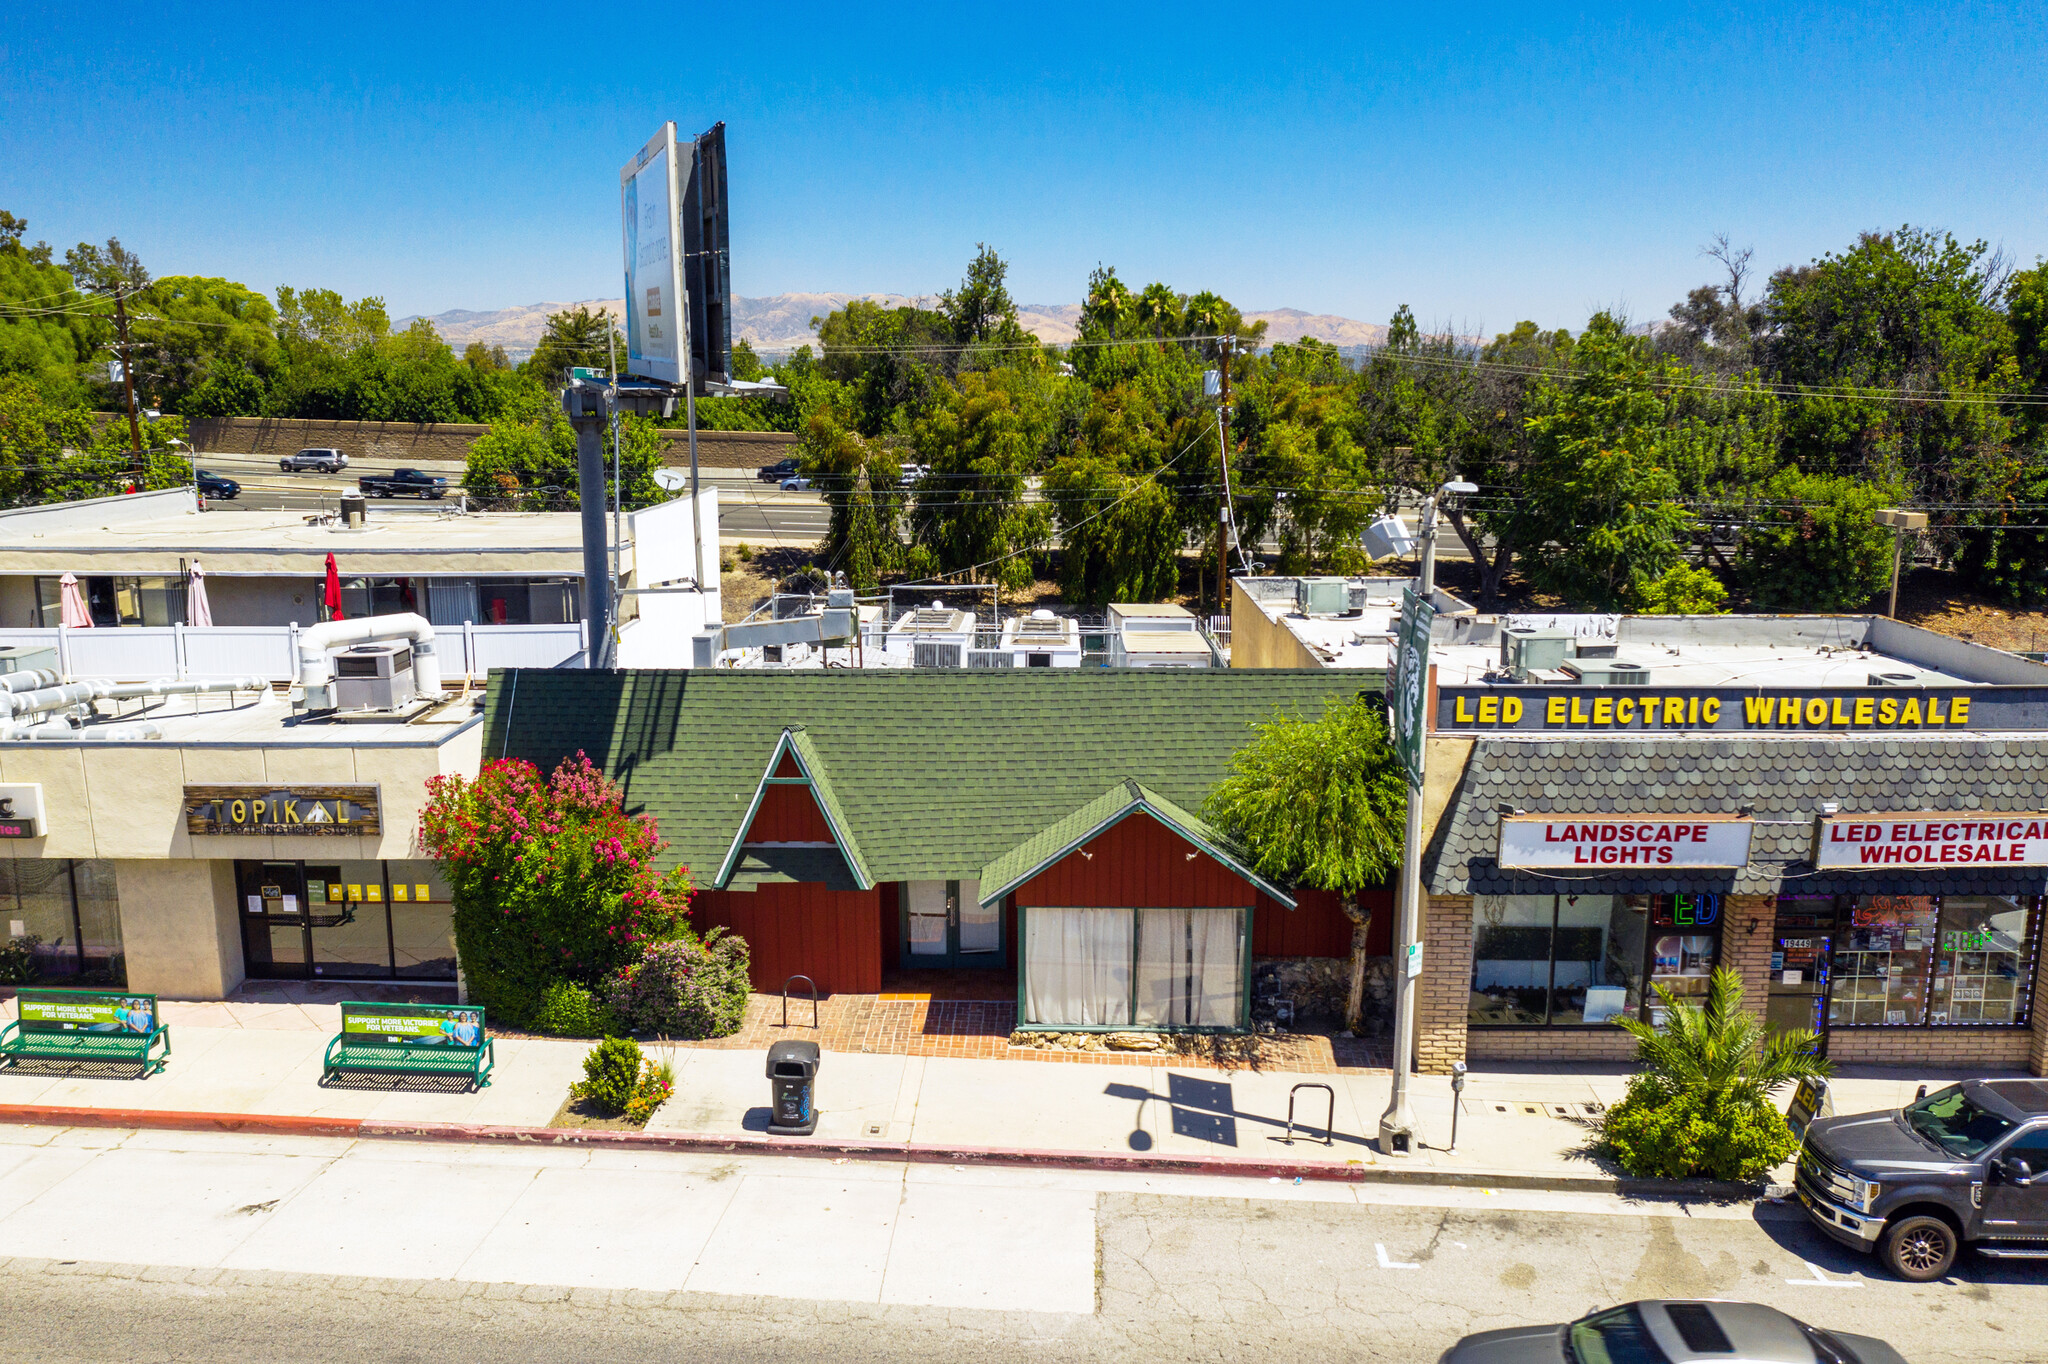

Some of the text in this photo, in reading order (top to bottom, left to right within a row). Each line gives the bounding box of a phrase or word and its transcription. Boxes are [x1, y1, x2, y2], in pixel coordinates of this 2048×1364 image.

[1455, 696, 1972, 726] LED ELECTRIC WHOLESALE
[207, 824, 364, 835] EVERYTHING HEMP STORE
[1546, 824, 1708, 842] LANDSCAPE
[1832, 823, 1884, 843] LED
[1575, 844, 1673, 864] LIGHTS
[1861, 843, 2026, 864] WHOLESALE
[1654, 894, 1719, 924] LED
[1785, 939, 1811, 948] 19449
[23, 1004, 113, 1015] SUPPORT MORE VICTORIES
[56, 1011, 95, 1020] VETERANS.
[347, 1016, 439, 1027] SUPPORT MORE VICTORIES
[381, 1025, 420, 1033] VETERANS.
